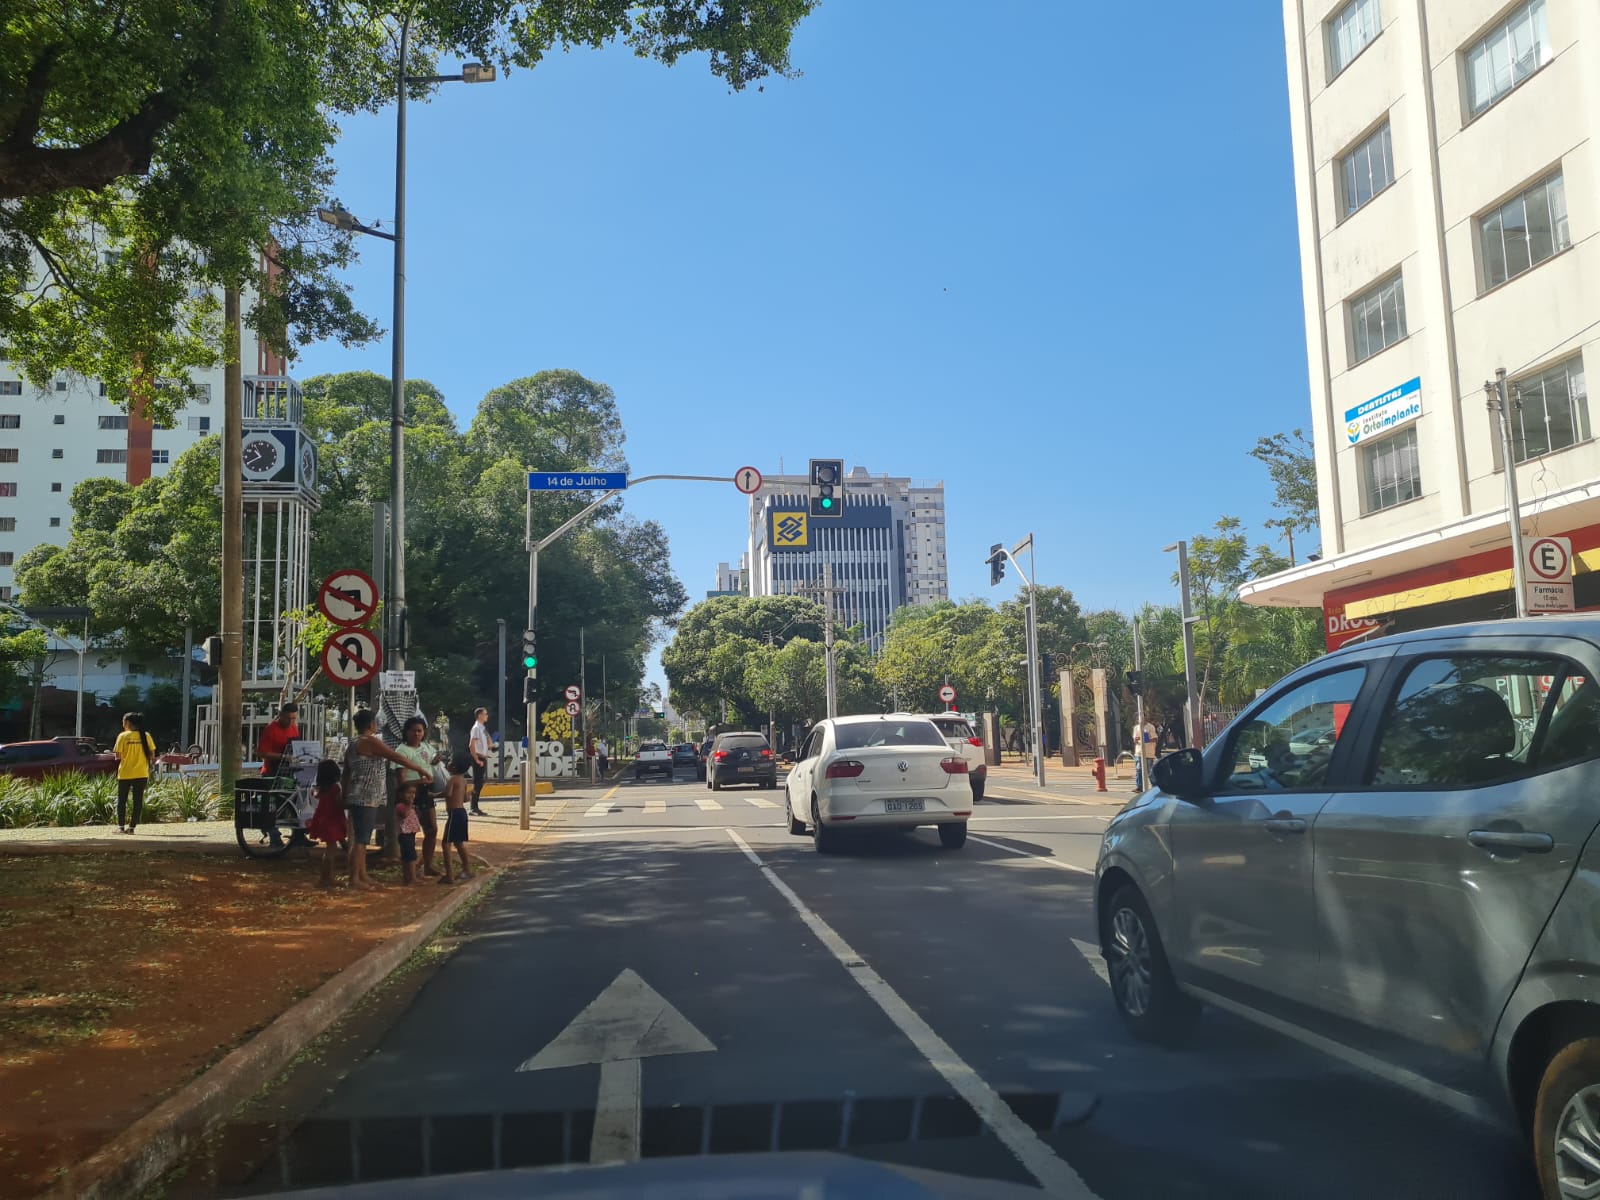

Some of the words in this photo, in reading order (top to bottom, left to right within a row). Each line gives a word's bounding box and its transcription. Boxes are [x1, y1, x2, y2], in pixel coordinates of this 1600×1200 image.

[1362, 403, 1420, 435] Ortoimplante
[547, 476, 558, 486] 14
[560, 476, 573, 486] de
[576, 476, 607, 486] Julho
[1541, 547, 1556, 570] E
